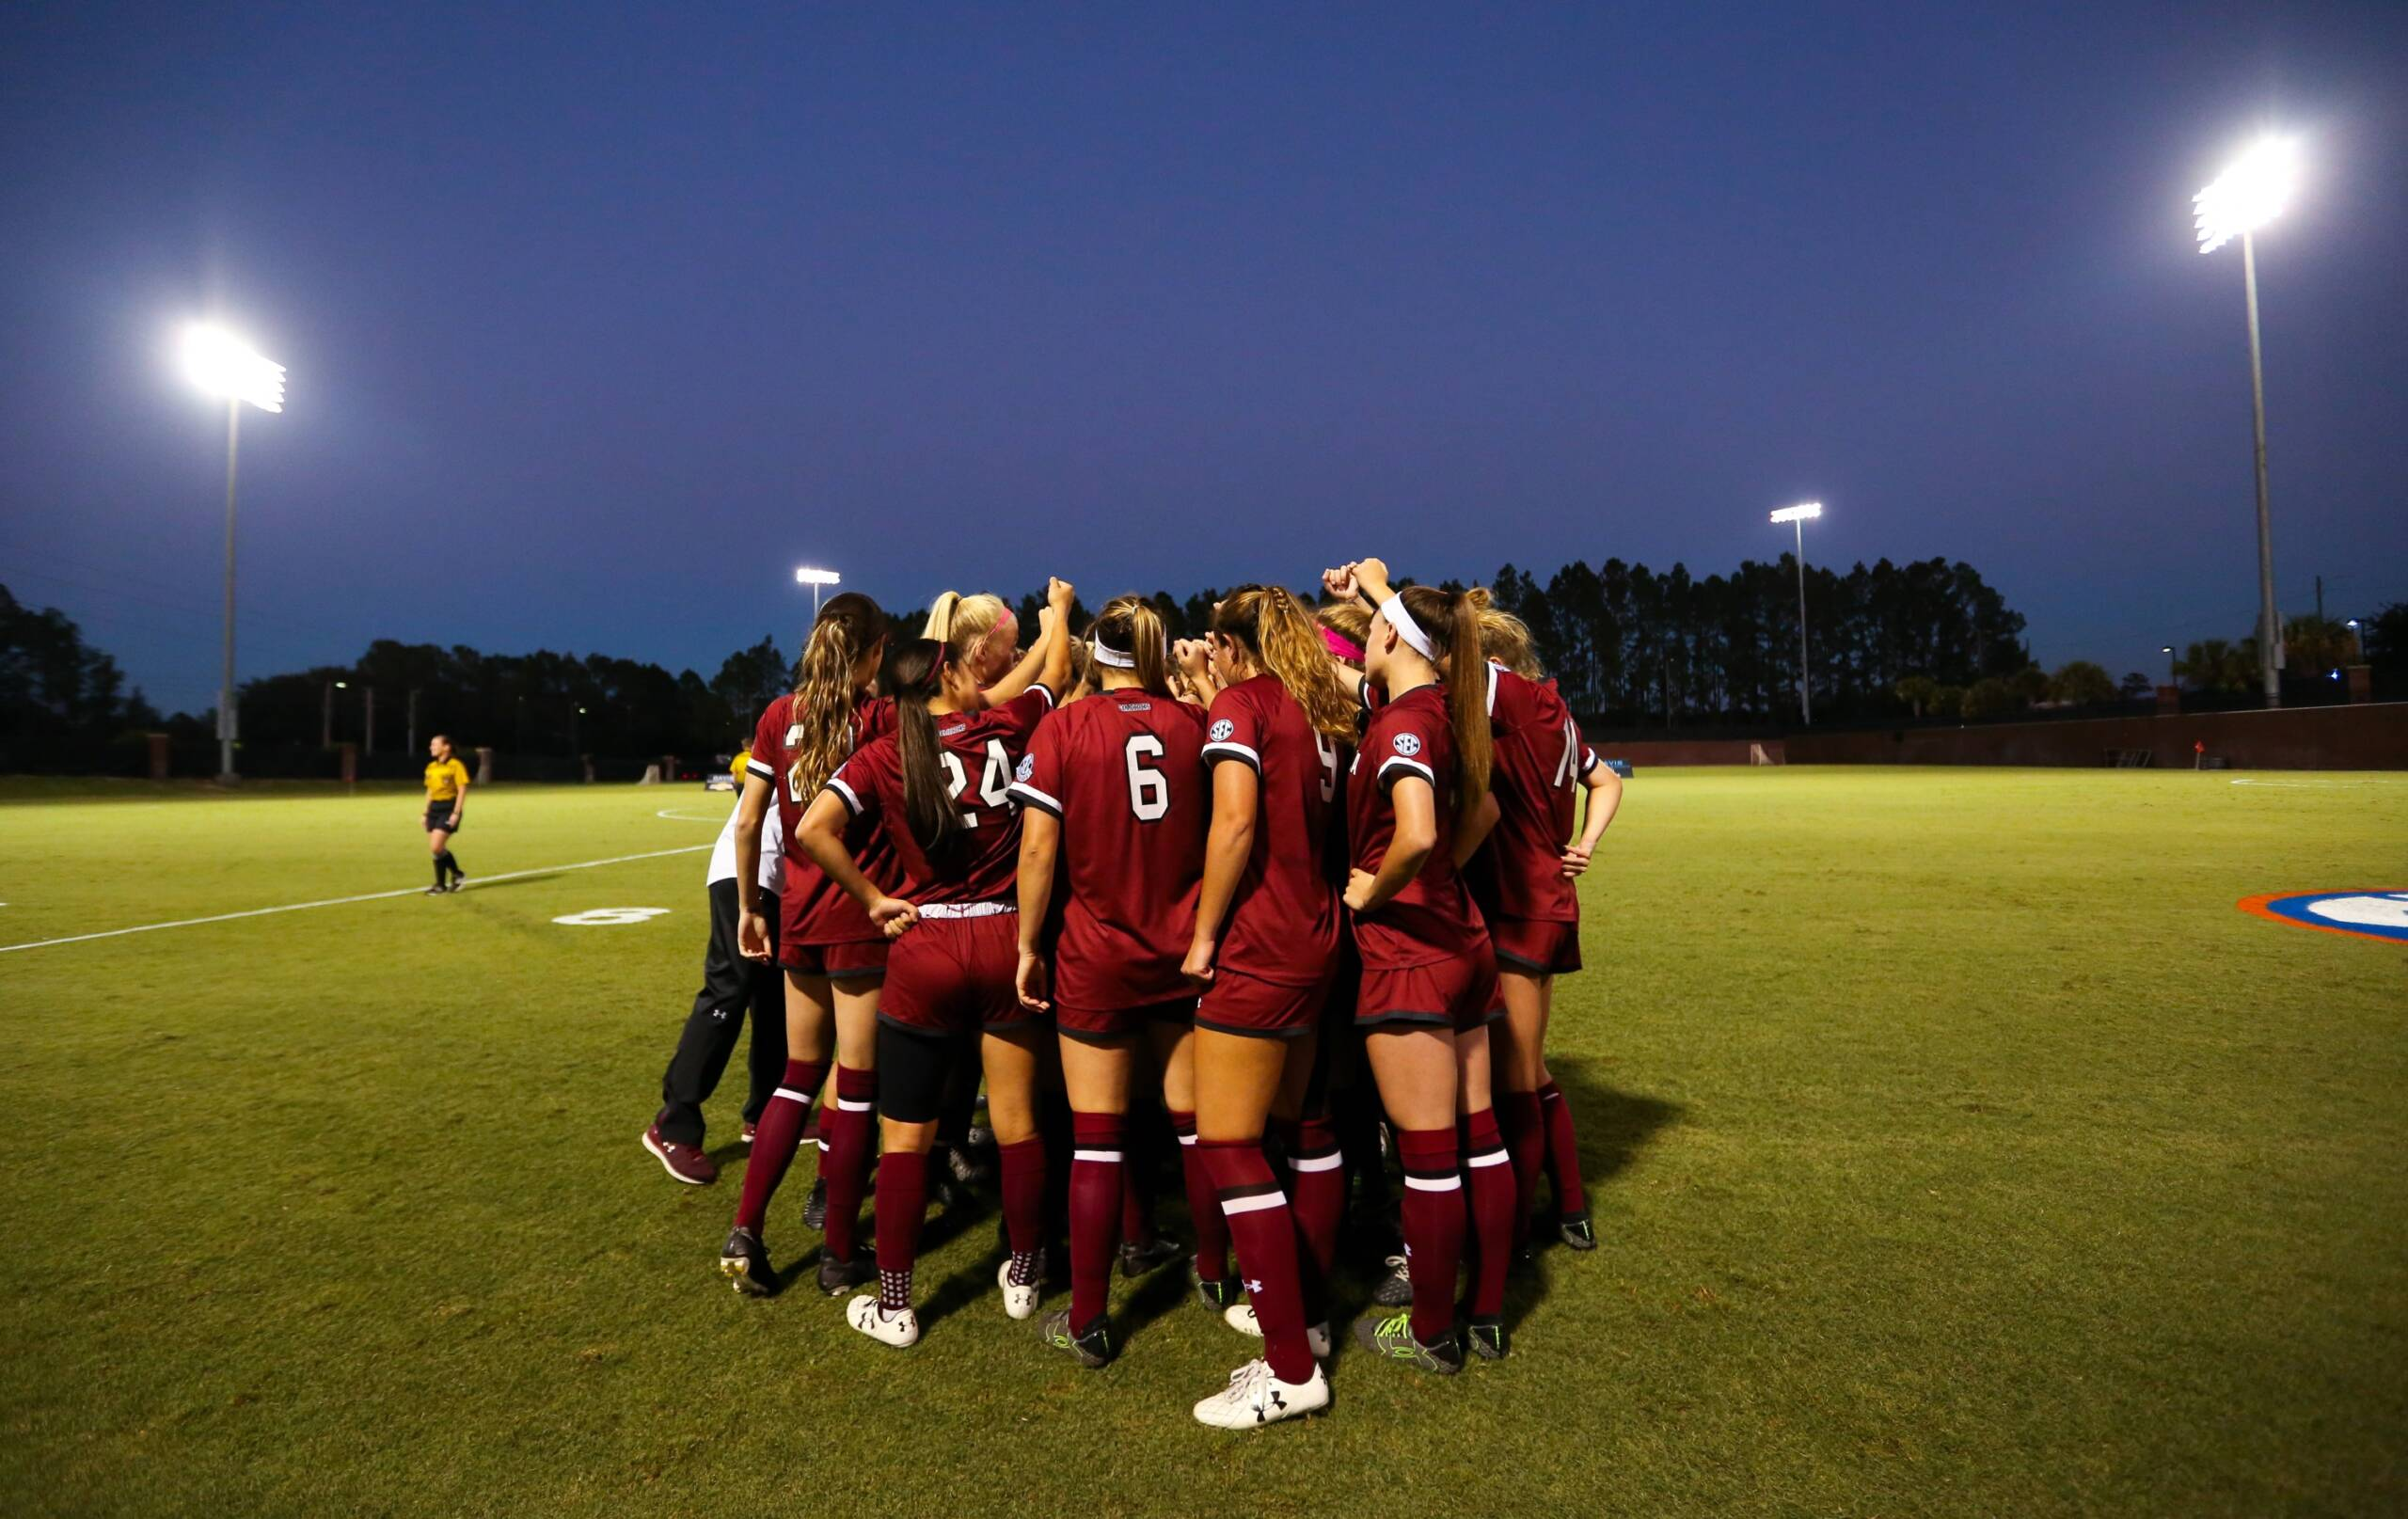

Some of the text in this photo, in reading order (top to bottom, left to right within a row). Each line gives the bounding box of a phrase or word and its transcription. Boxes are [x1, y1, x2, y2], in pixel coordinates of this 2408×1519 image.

[1212, 720, 1232, 740] SEC
[1395, 734, 1419, 754] SEC
[1125, 735, 1169, 821] 6
